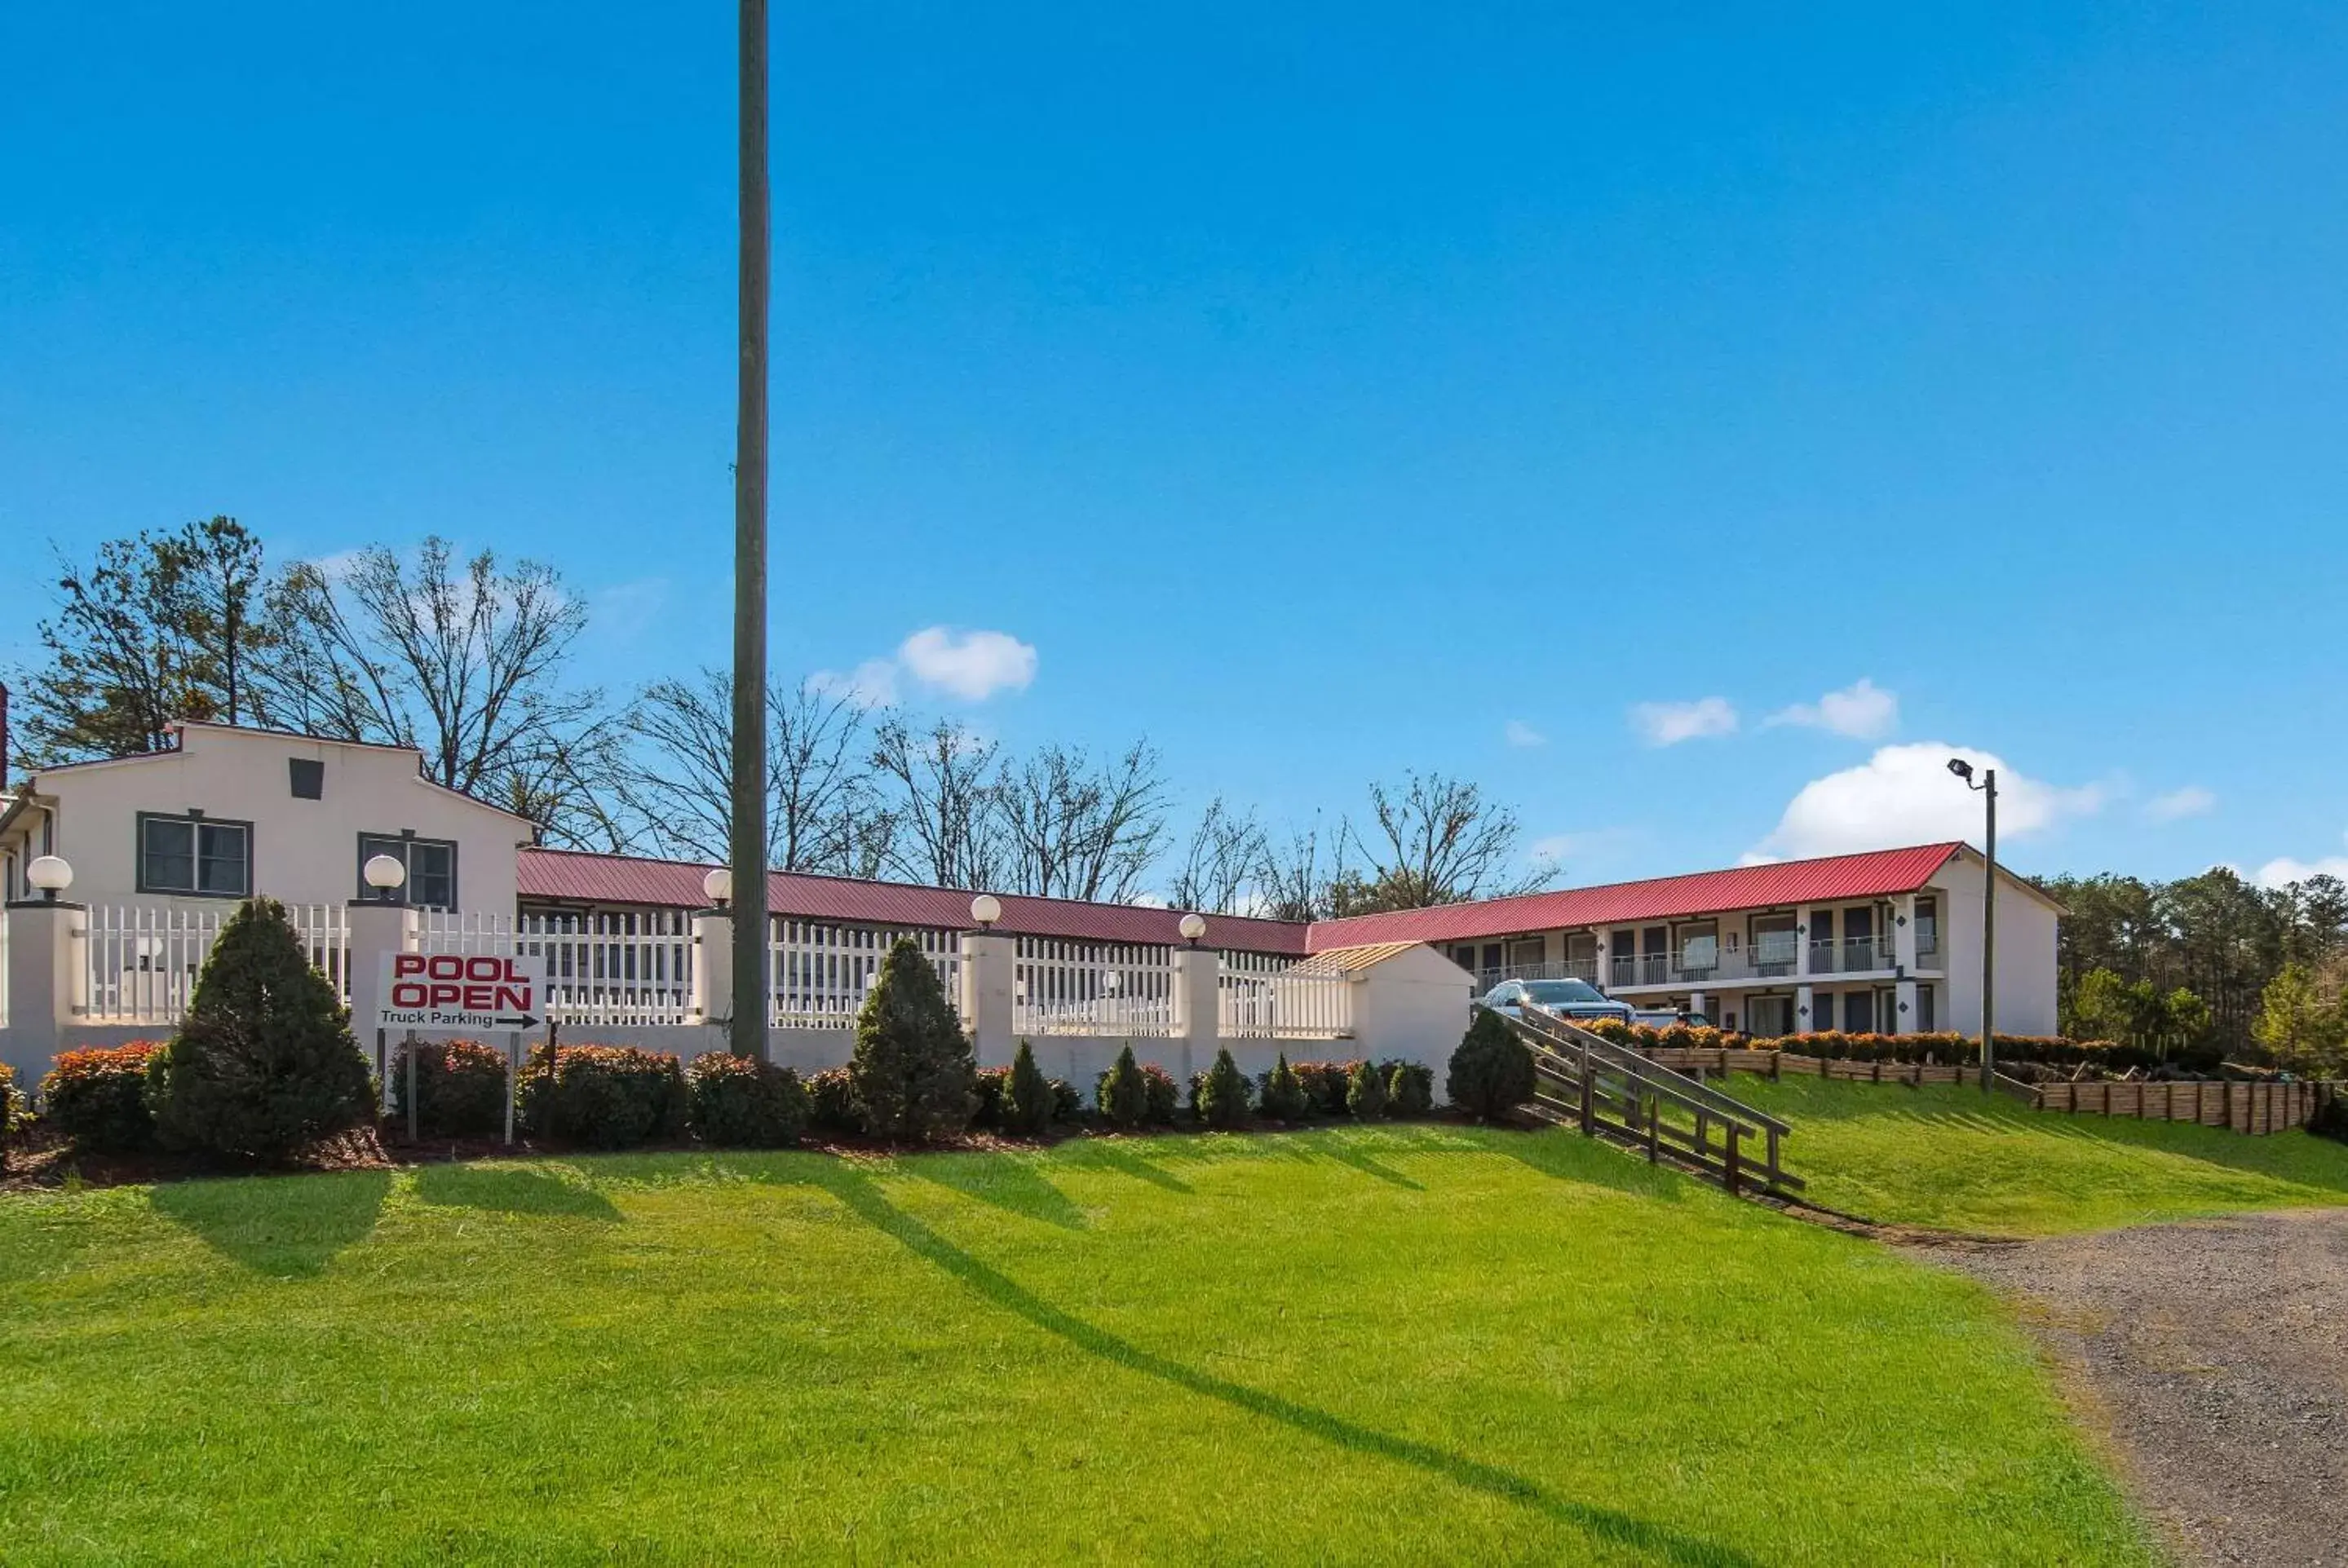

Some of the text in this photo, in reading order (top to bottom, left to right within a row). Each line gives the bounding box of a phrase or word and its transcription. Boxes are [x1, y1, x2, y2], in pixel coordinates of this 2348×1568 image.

[394, 954, 530, 983] POOL
[392, 983, 531, 1011] OPEN
[381, 1010, 493, 1028] Truck Parking
